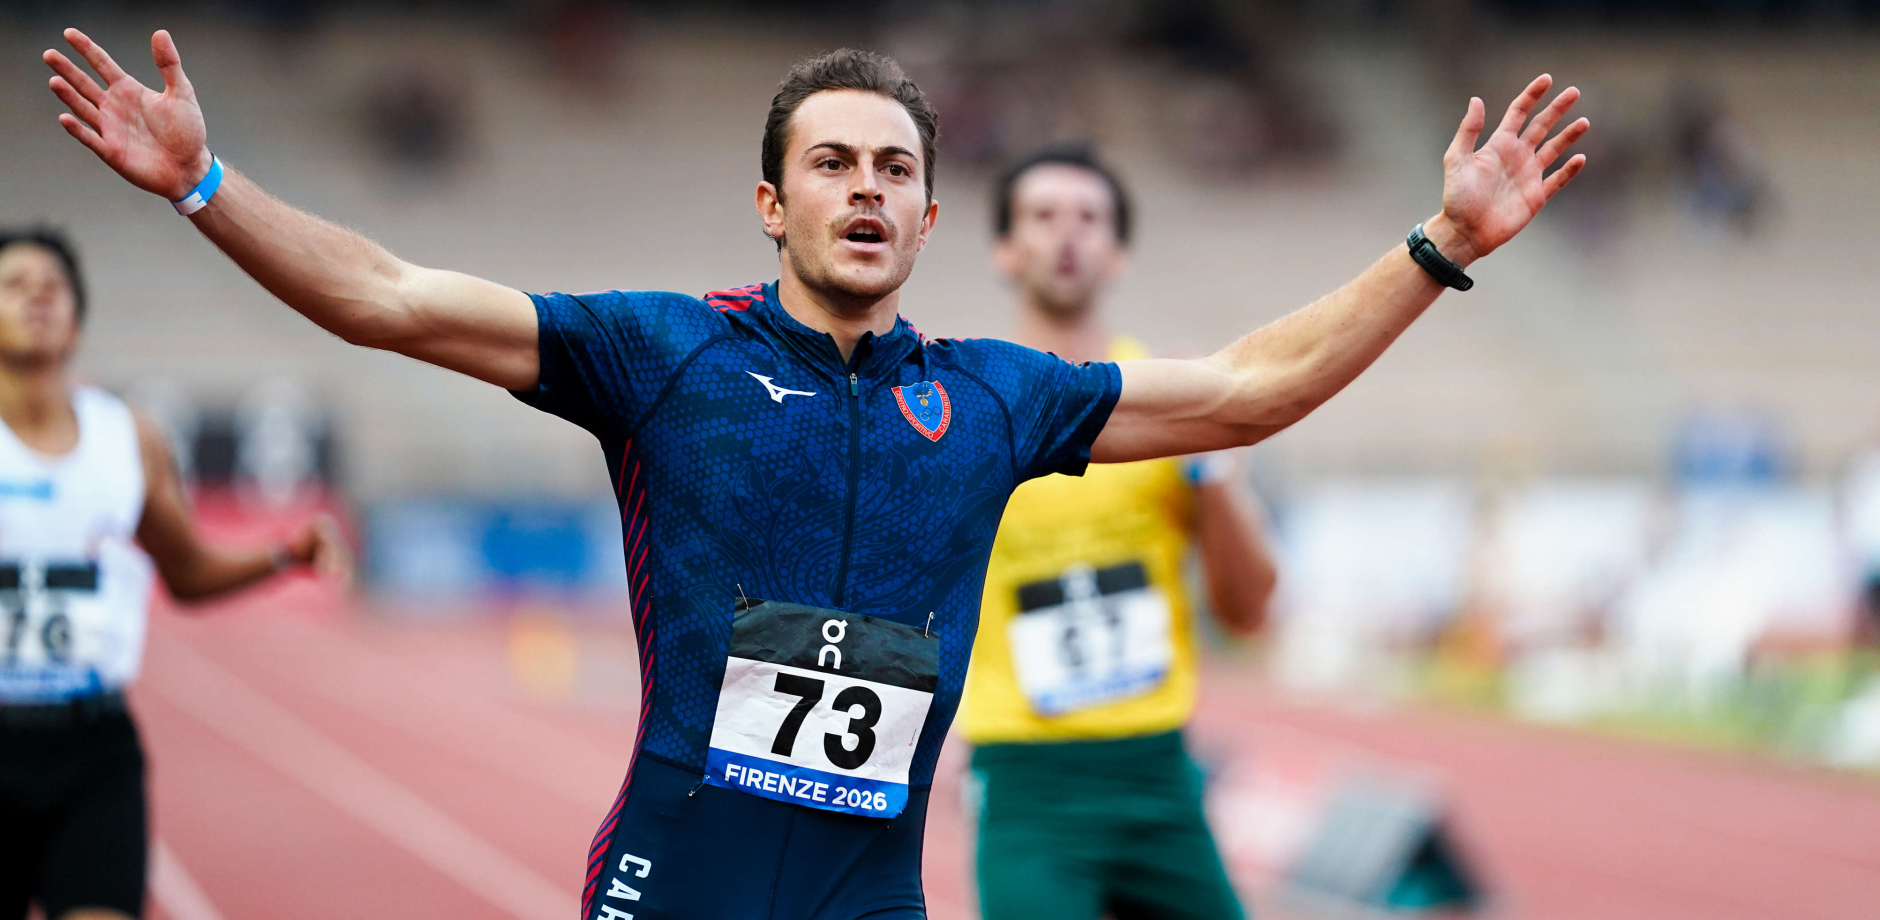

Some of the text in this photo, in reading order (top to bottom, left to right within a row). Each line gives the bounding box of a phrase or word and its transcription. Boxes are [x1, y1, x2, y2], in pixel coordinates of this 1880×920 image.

[894, 390, 934, 438] CENTRO SPORTIVO
[770, 671, 882, 770] 73
[724, 763, 888, 811] FIRENZE 2026
